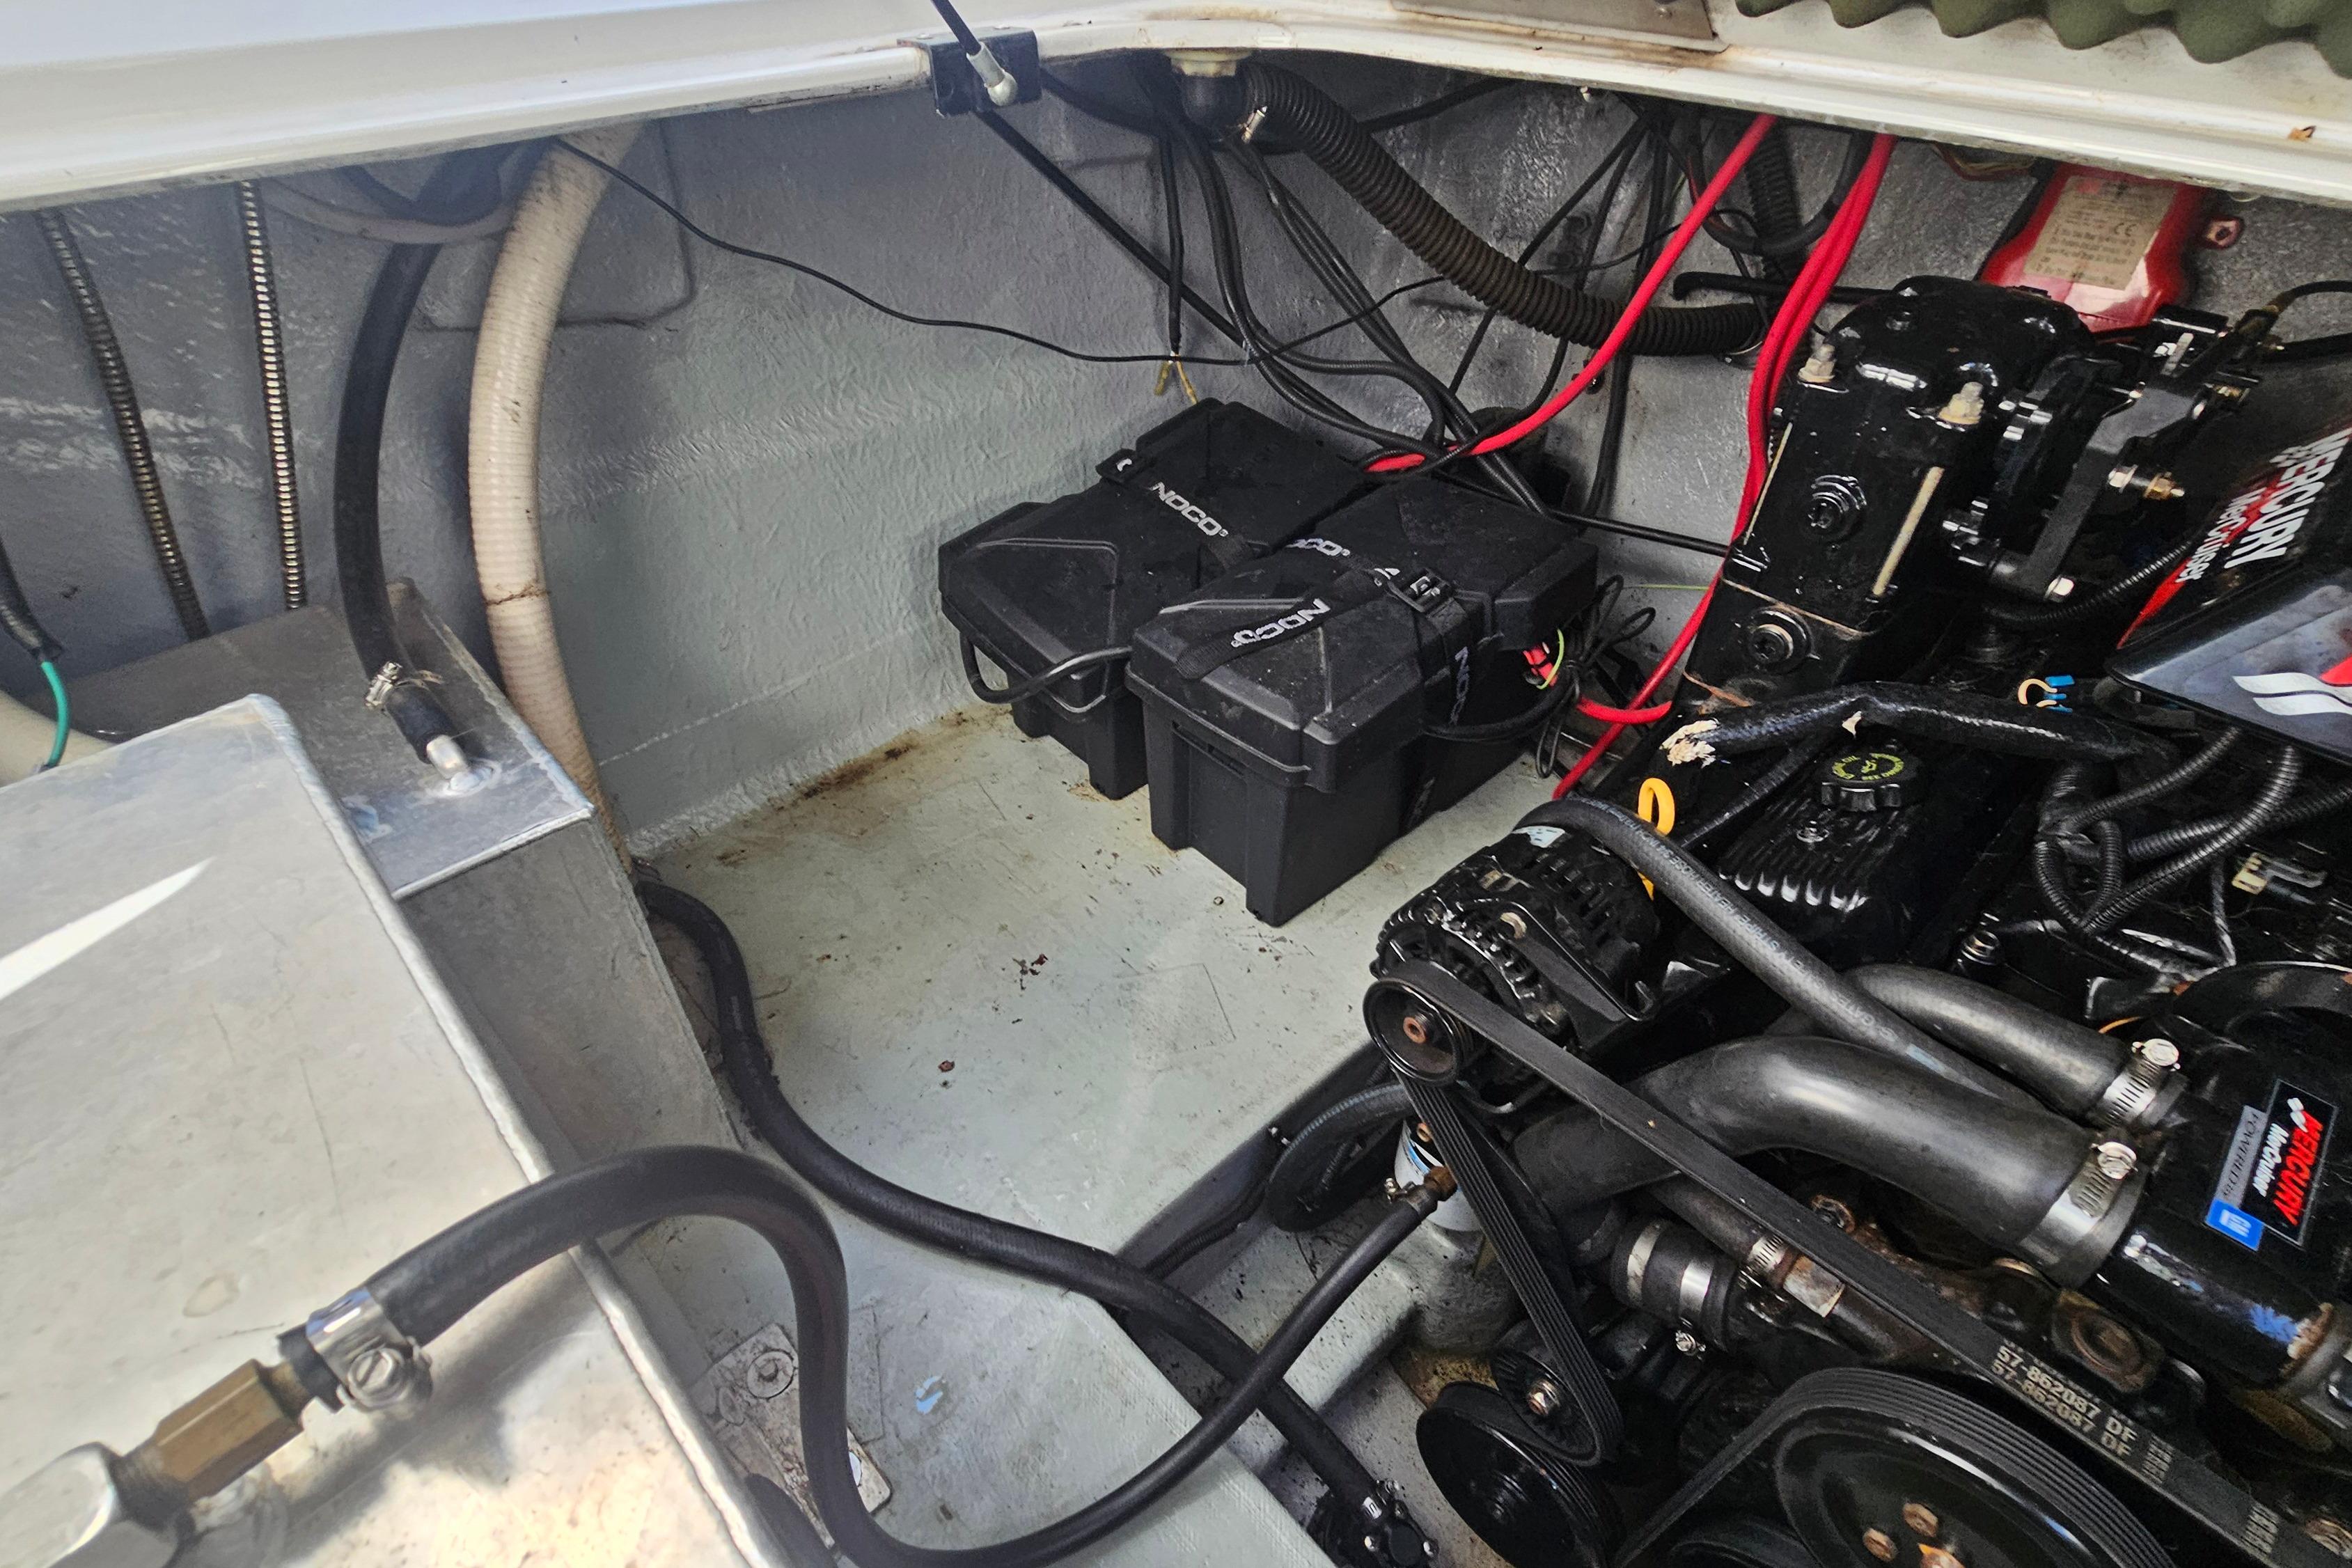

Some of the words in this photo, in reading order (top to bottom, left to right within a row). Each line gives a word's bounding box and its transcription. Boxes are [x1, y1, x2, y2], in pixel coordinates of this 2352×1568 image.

[1149, 482, 1228, 536] NOCO
[2175, 487, 2268, 583] MerCruiser
[2224, 428, 2352, 568] MERCURY
[1232, 599, 1331, 647] NOCO
[2272, 1110, 2323, 1227] MERCURY
